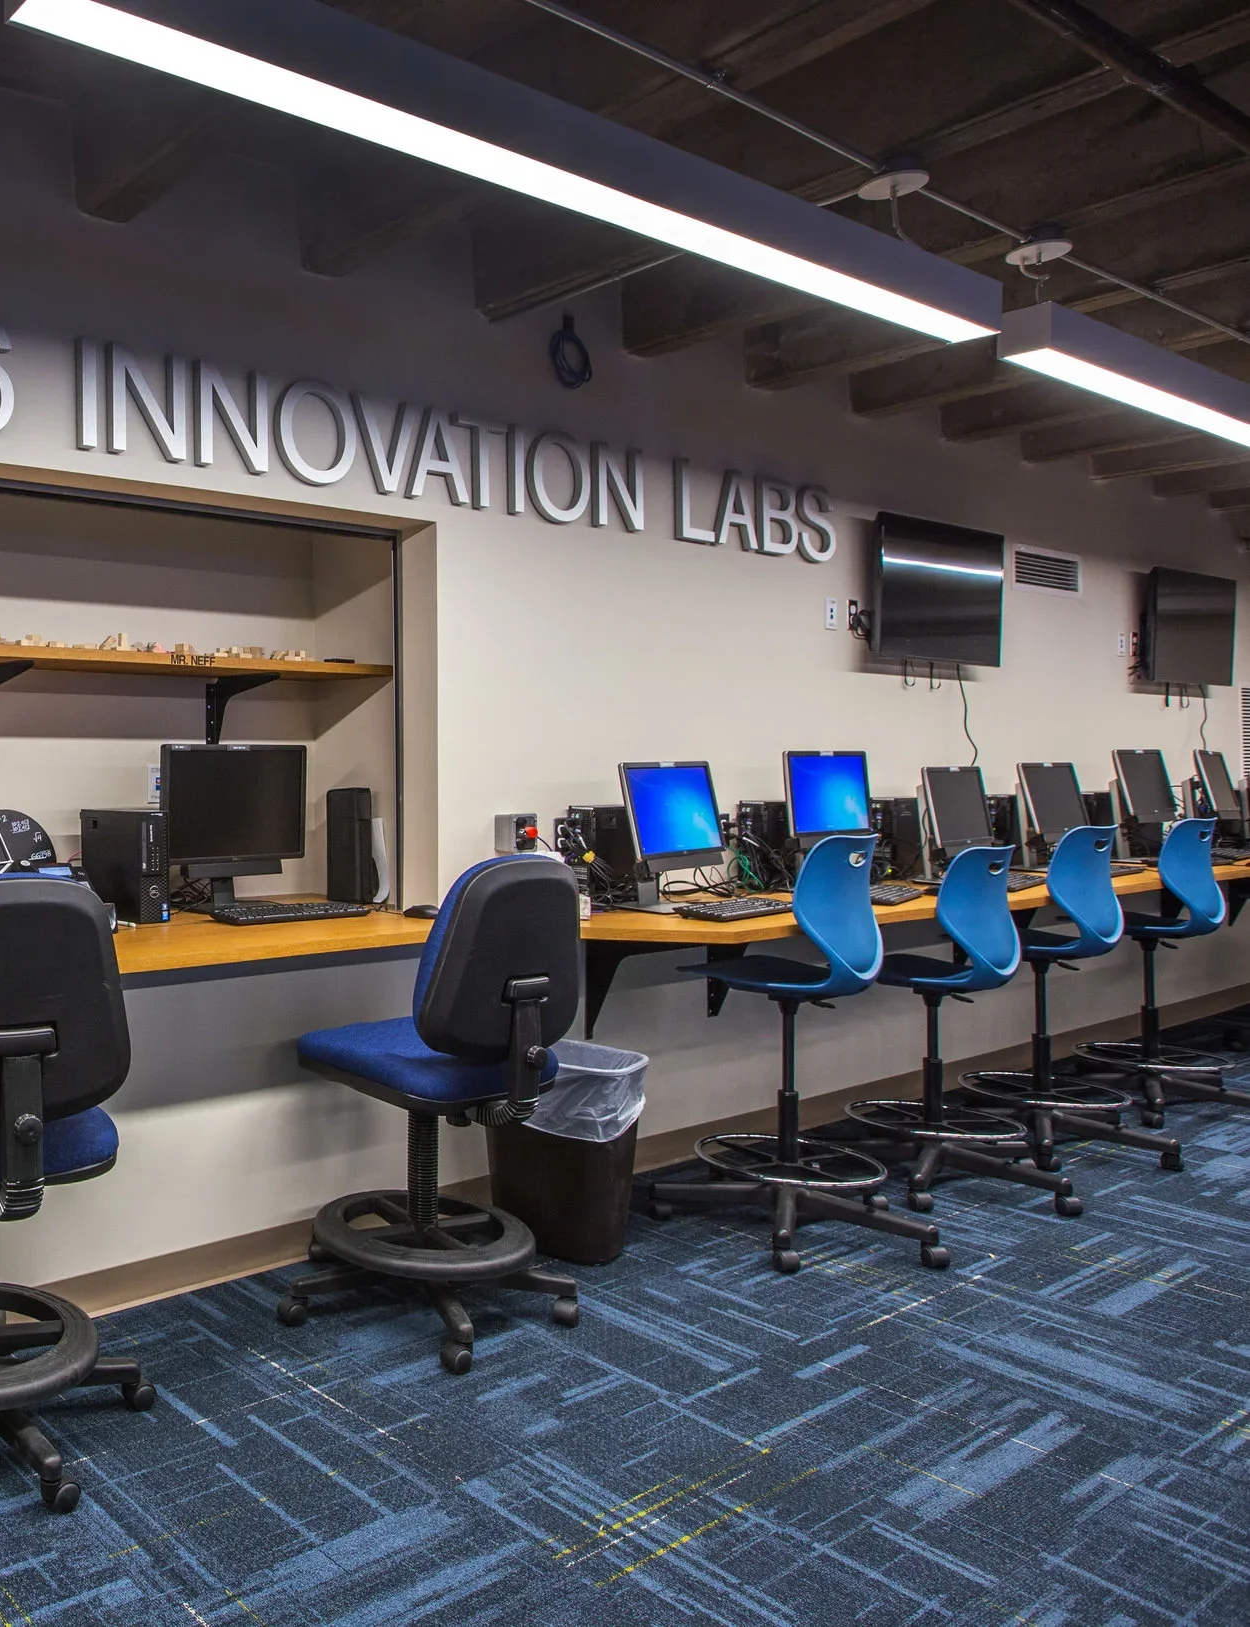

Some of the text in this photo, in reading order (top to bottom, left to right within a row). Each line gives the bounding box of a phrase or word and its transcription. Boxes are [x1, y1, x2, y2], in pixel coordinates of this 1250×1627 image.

[75, 337, 645, 533] INNOVATION
[673, 457, 837, 563] LABS
[170, 654, 216, 666] MR. NEFF
